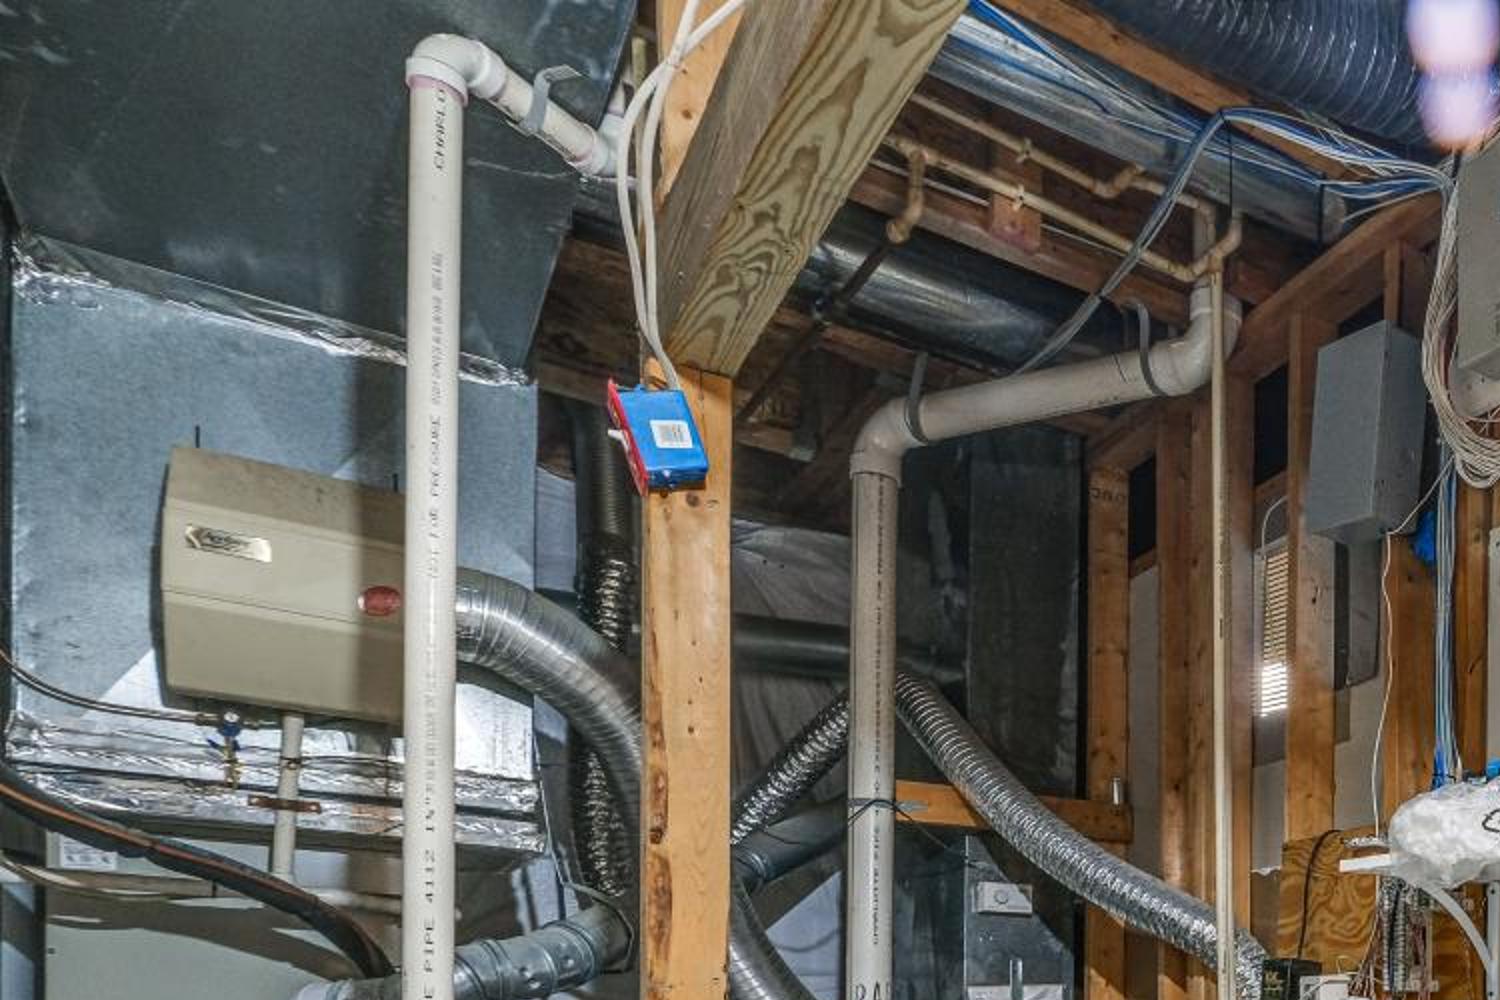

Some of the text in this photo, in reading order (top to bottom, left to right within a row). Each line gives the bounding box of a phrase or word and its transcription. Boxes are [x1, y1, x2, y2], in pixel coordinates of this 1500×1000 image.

[426, 415, 441, 498] PRESSURE
[423, 849, 436, 904] 4112
[422, 917, 436, 974] PIPE
